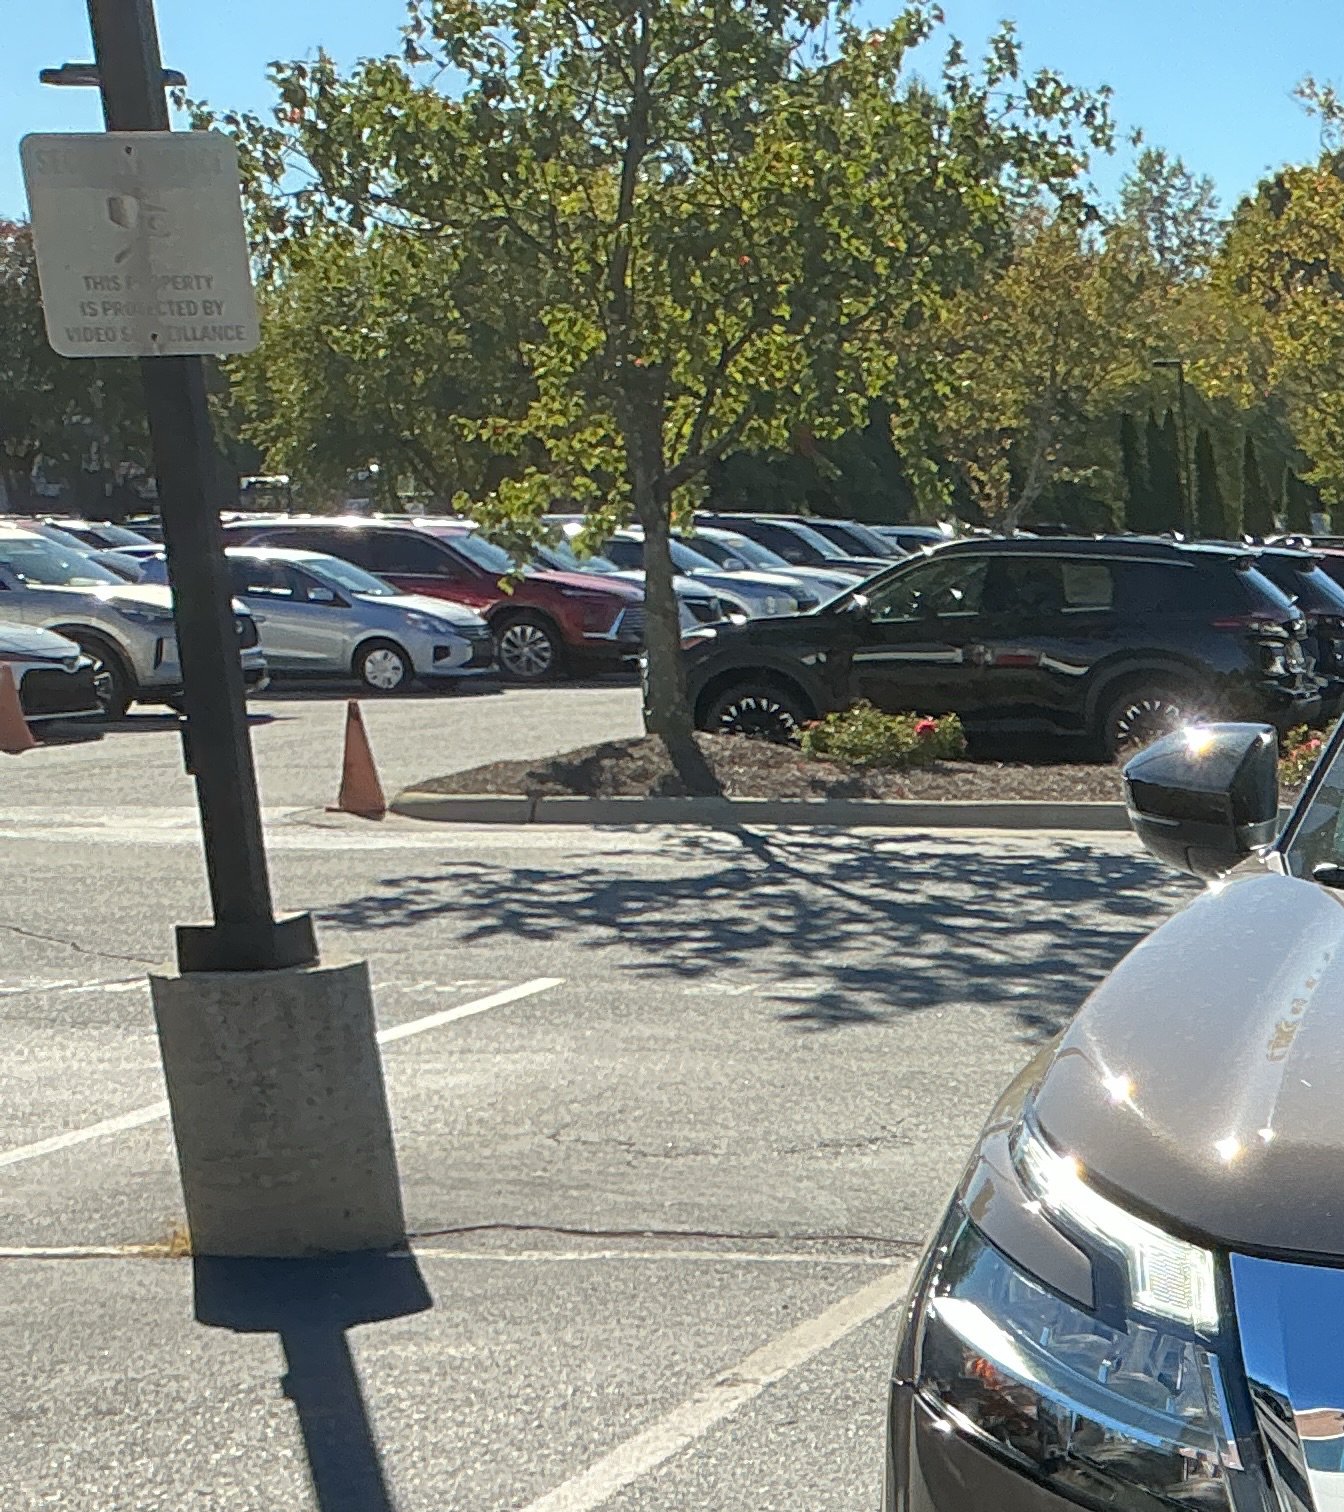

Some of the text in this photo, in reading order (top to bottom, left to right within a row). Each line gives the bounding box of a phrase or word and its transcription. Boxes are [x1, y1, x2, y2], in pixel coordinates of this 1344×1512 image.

[82, 273, 214, 291] THIS PPERTY
[79, 298, 224, 317] IS PROECTED BY
[64, 324, 248, 342] VIDEO SEILLANCE
